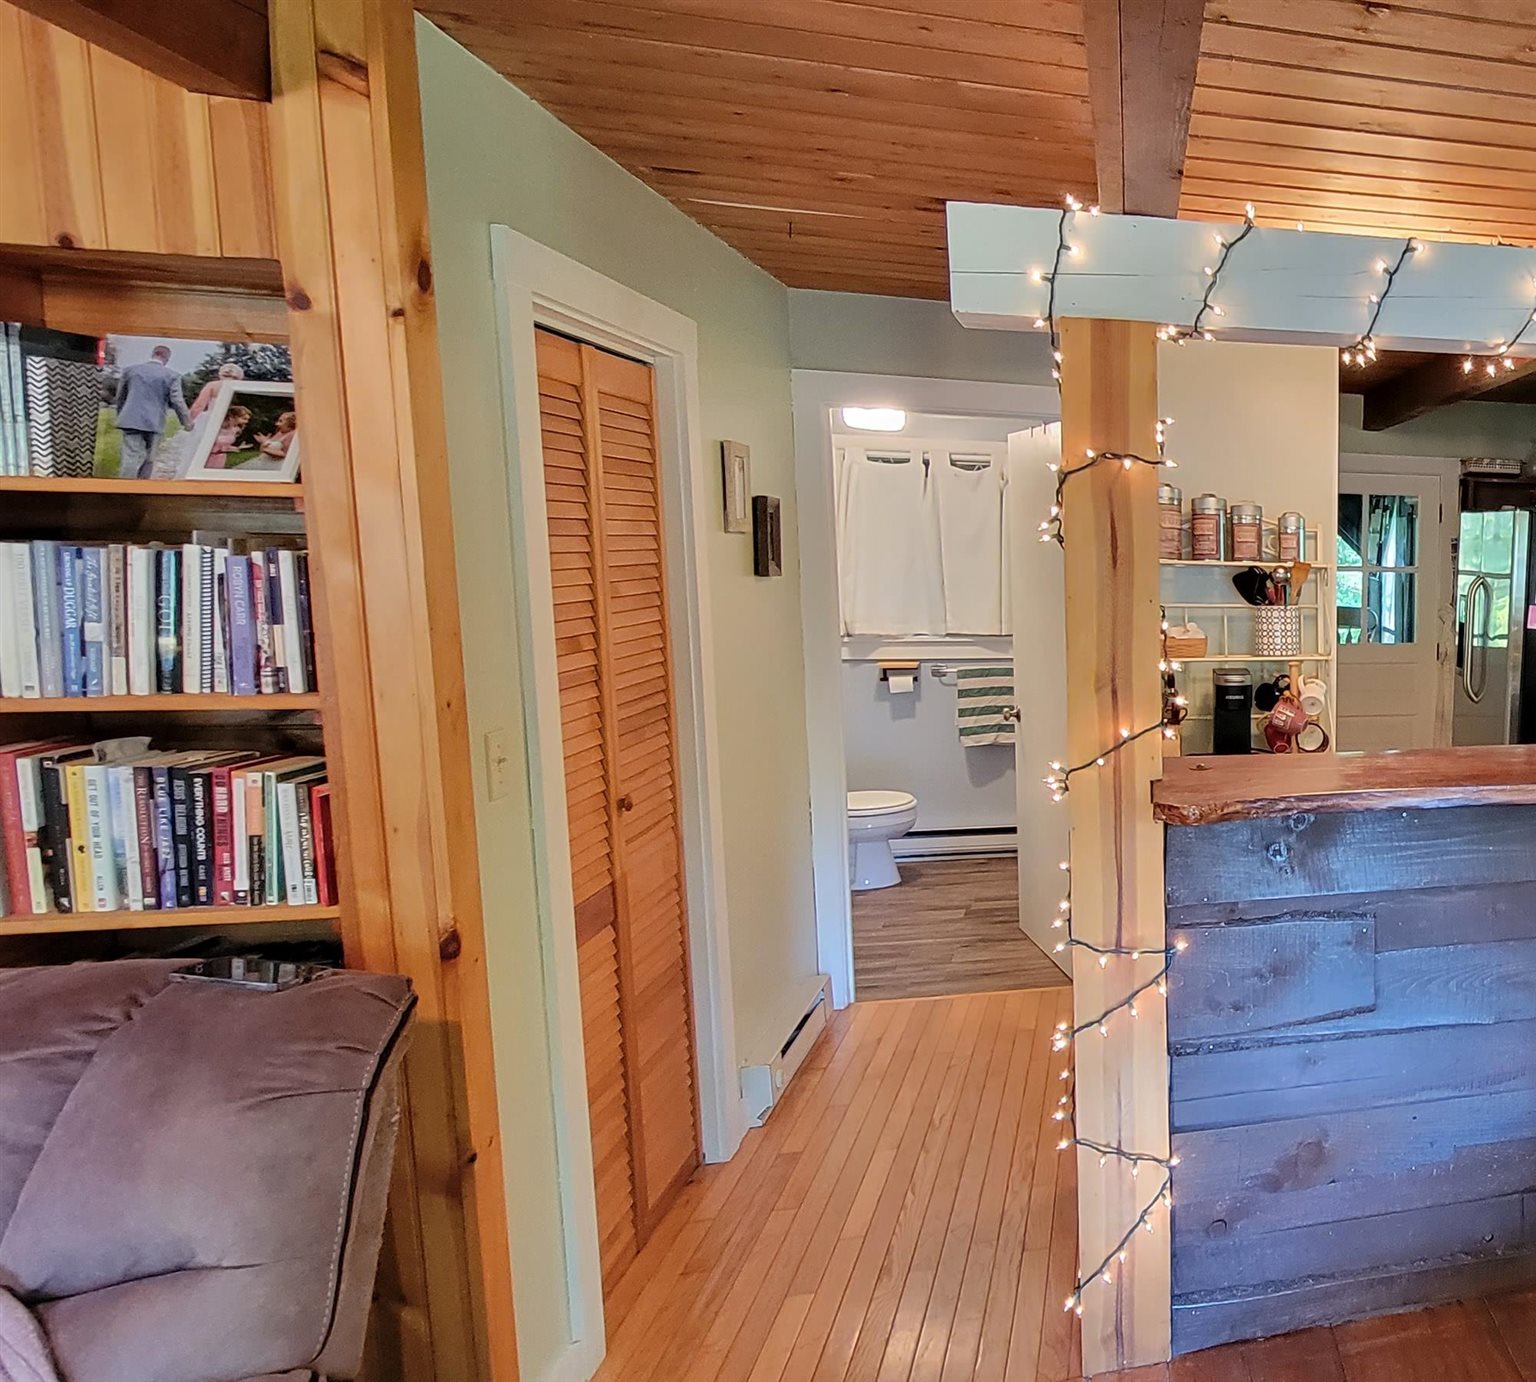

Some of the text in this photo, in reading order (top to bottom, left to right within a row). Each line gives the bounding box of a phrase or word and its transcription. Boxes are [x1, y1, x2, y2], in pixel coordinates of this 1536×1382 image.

[63, 587, 77, 629] DUGGAR
[232, 566, 247, 626] ROBYN CARR
[156, 777, 167, 802] BLUE
[216, 786, 228, 813] HARD
[136, 787, 151, 845] RESOLUTION
[158, 808, 169, 830] LIKE
[173, 779, 187, 835] JESUS RELIGION
[193, 778, 206, 860] EVERYTHING COUNTS
[91, 821, 101, 838] YOUR
[216, 812, 229, 847] THINGS
[93, 841, 103, 859] HEAD
[160, 835, 170, 860] JAZZ
